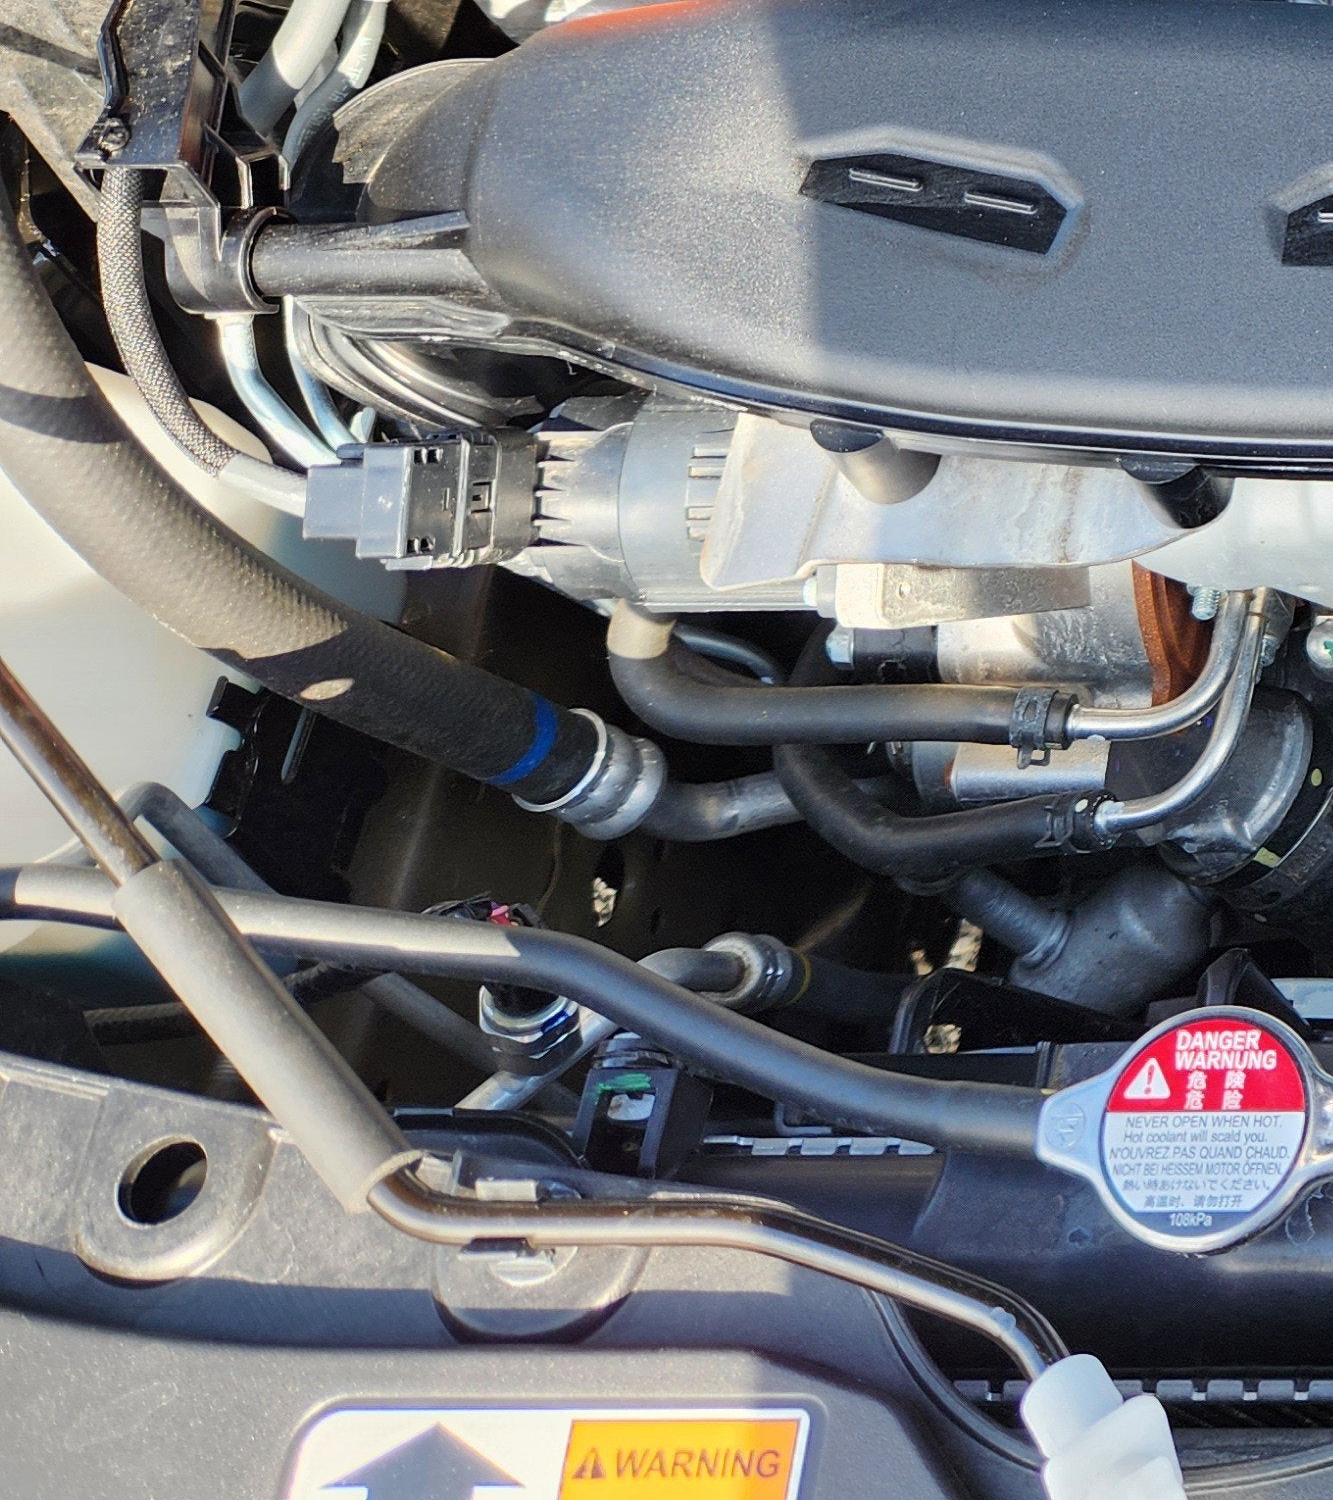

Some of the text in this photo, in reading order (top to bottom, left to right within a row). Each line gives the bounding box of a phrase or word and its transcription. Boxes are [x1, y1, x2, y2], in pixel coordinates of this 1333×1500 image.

[1175, 1029, 1262, 1051] DANGER
[1174, 1050, 1277, 1071] WARNUNG
[1126, 1115, 1283, 1128] NEVER OPEN WHEN HOT.
[1123, 1131, 1268, 1145] Hot coolant will scald you.
[1110, 1147, 1290, 1160] N'OUVREZ PAS QUAND CHAUD.
[1113, 1160, 1283, 1176] NICHT BEI HEISSEM MOTOR ÖFFNEN.
[1170, 1213, 1213, 1228] 108kPa
[616, 1448, 781, 1478] WARNING
